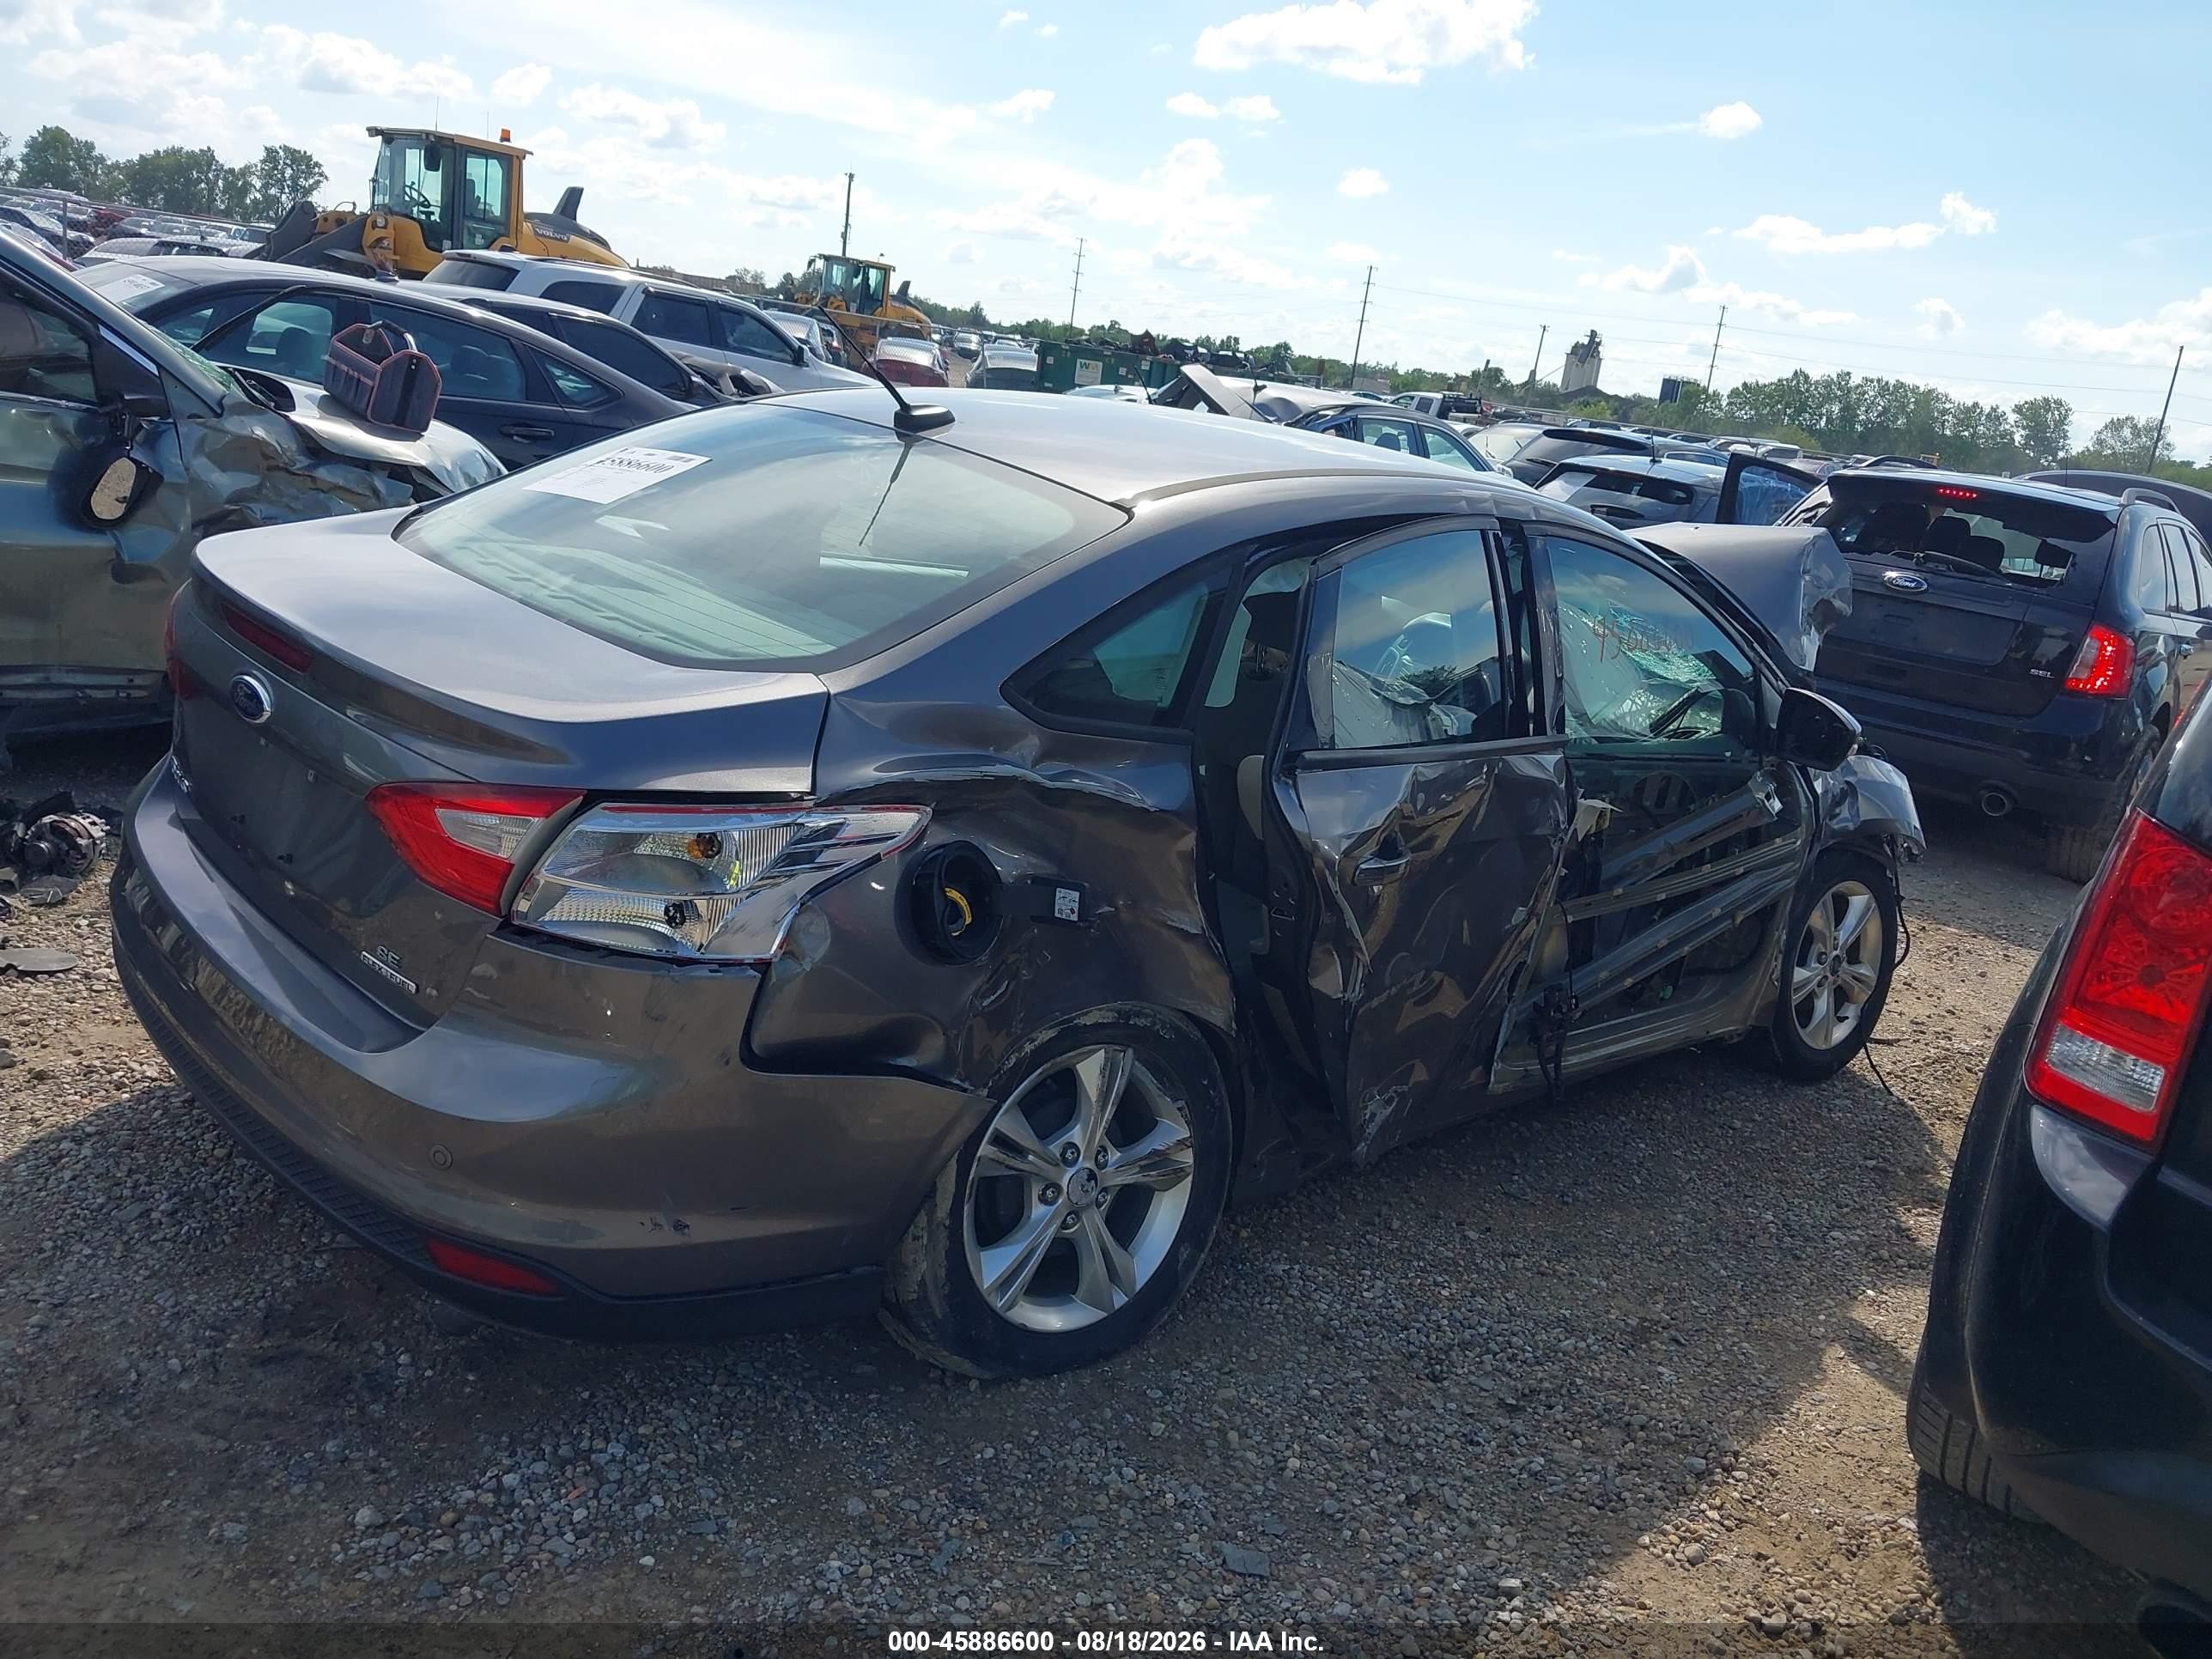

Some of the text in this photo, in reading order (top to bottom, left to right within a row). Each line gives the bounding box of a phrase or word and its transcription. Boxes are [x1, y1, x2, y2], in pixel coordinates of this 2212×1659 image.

[535, 228, 568, 240] VOLVO
[2029, 669, 2055, 678] SEL
[376, 945, 401, 969] SE
[362, 954, 416, 994] FLEX FUEL
